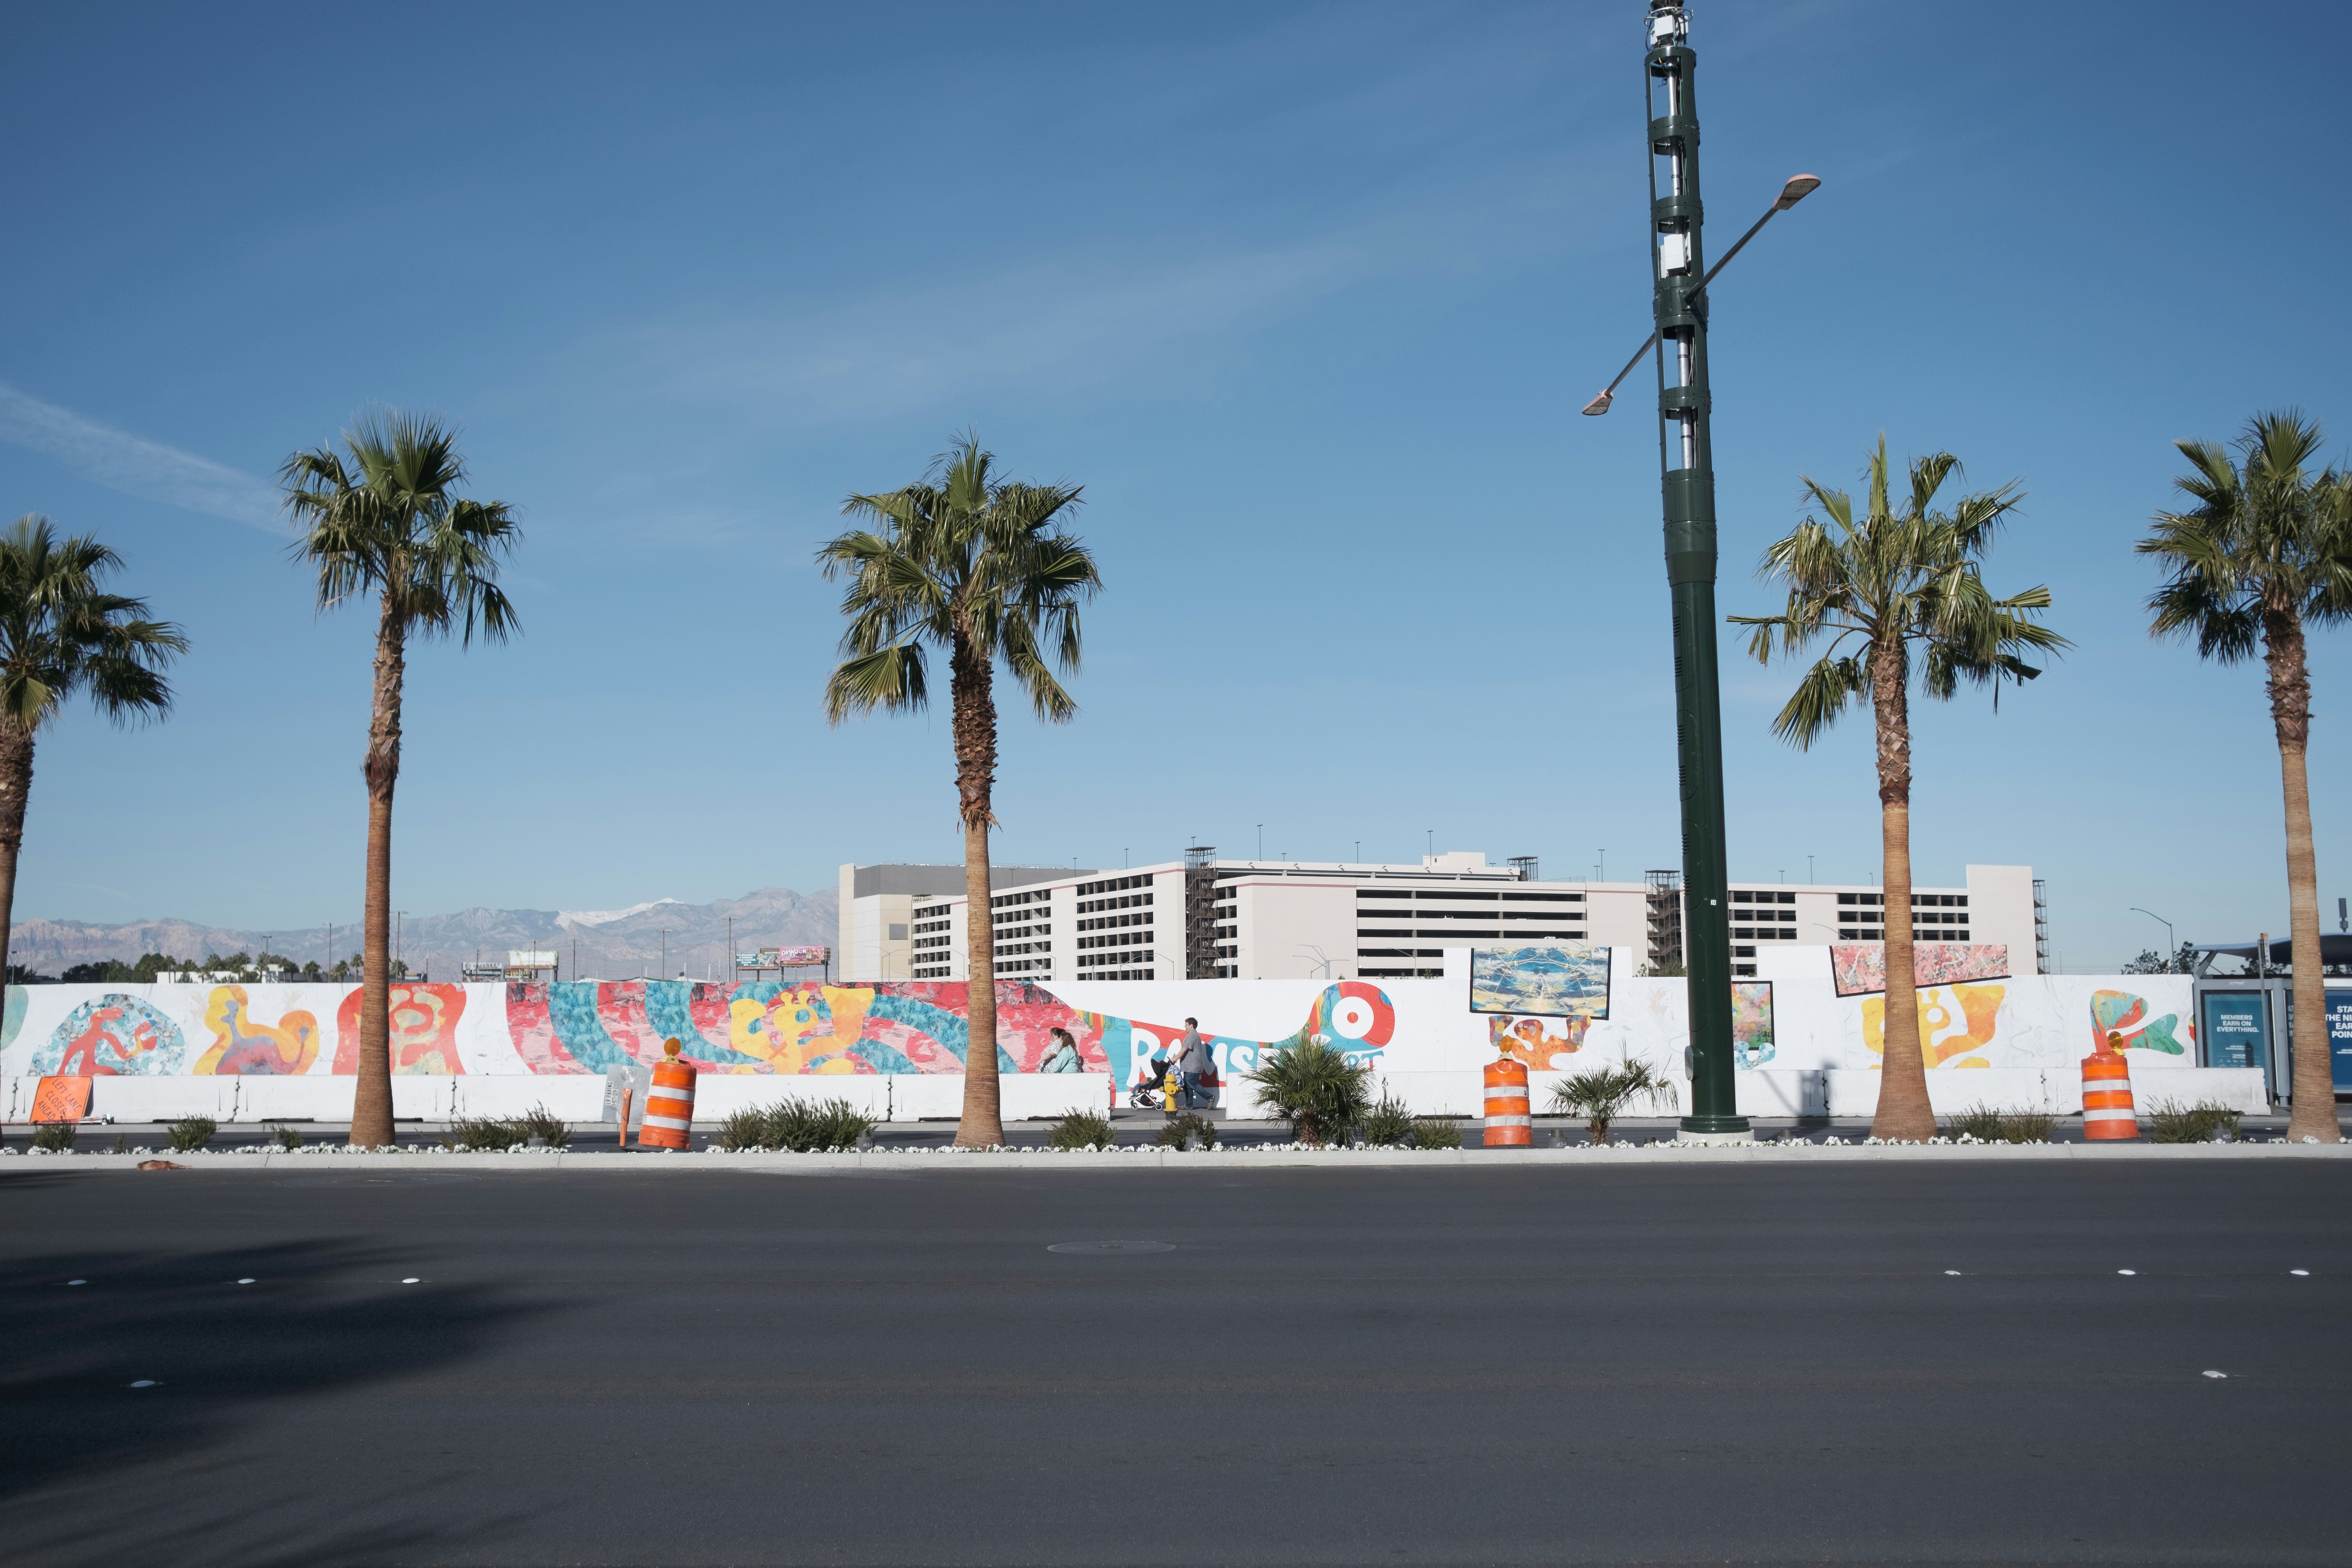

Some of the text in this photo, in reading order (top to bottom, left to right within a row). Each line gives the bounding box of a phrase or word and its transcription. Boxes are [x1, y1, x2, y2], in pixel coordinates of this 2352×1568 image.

[781, 947, 806, 957] pinkbox
[46, 1091, 67, 1114] CLOSED
[52, 1078, 82, 1112] LEFT LANE
[37, 1101, 55, 1120] AHEAD
